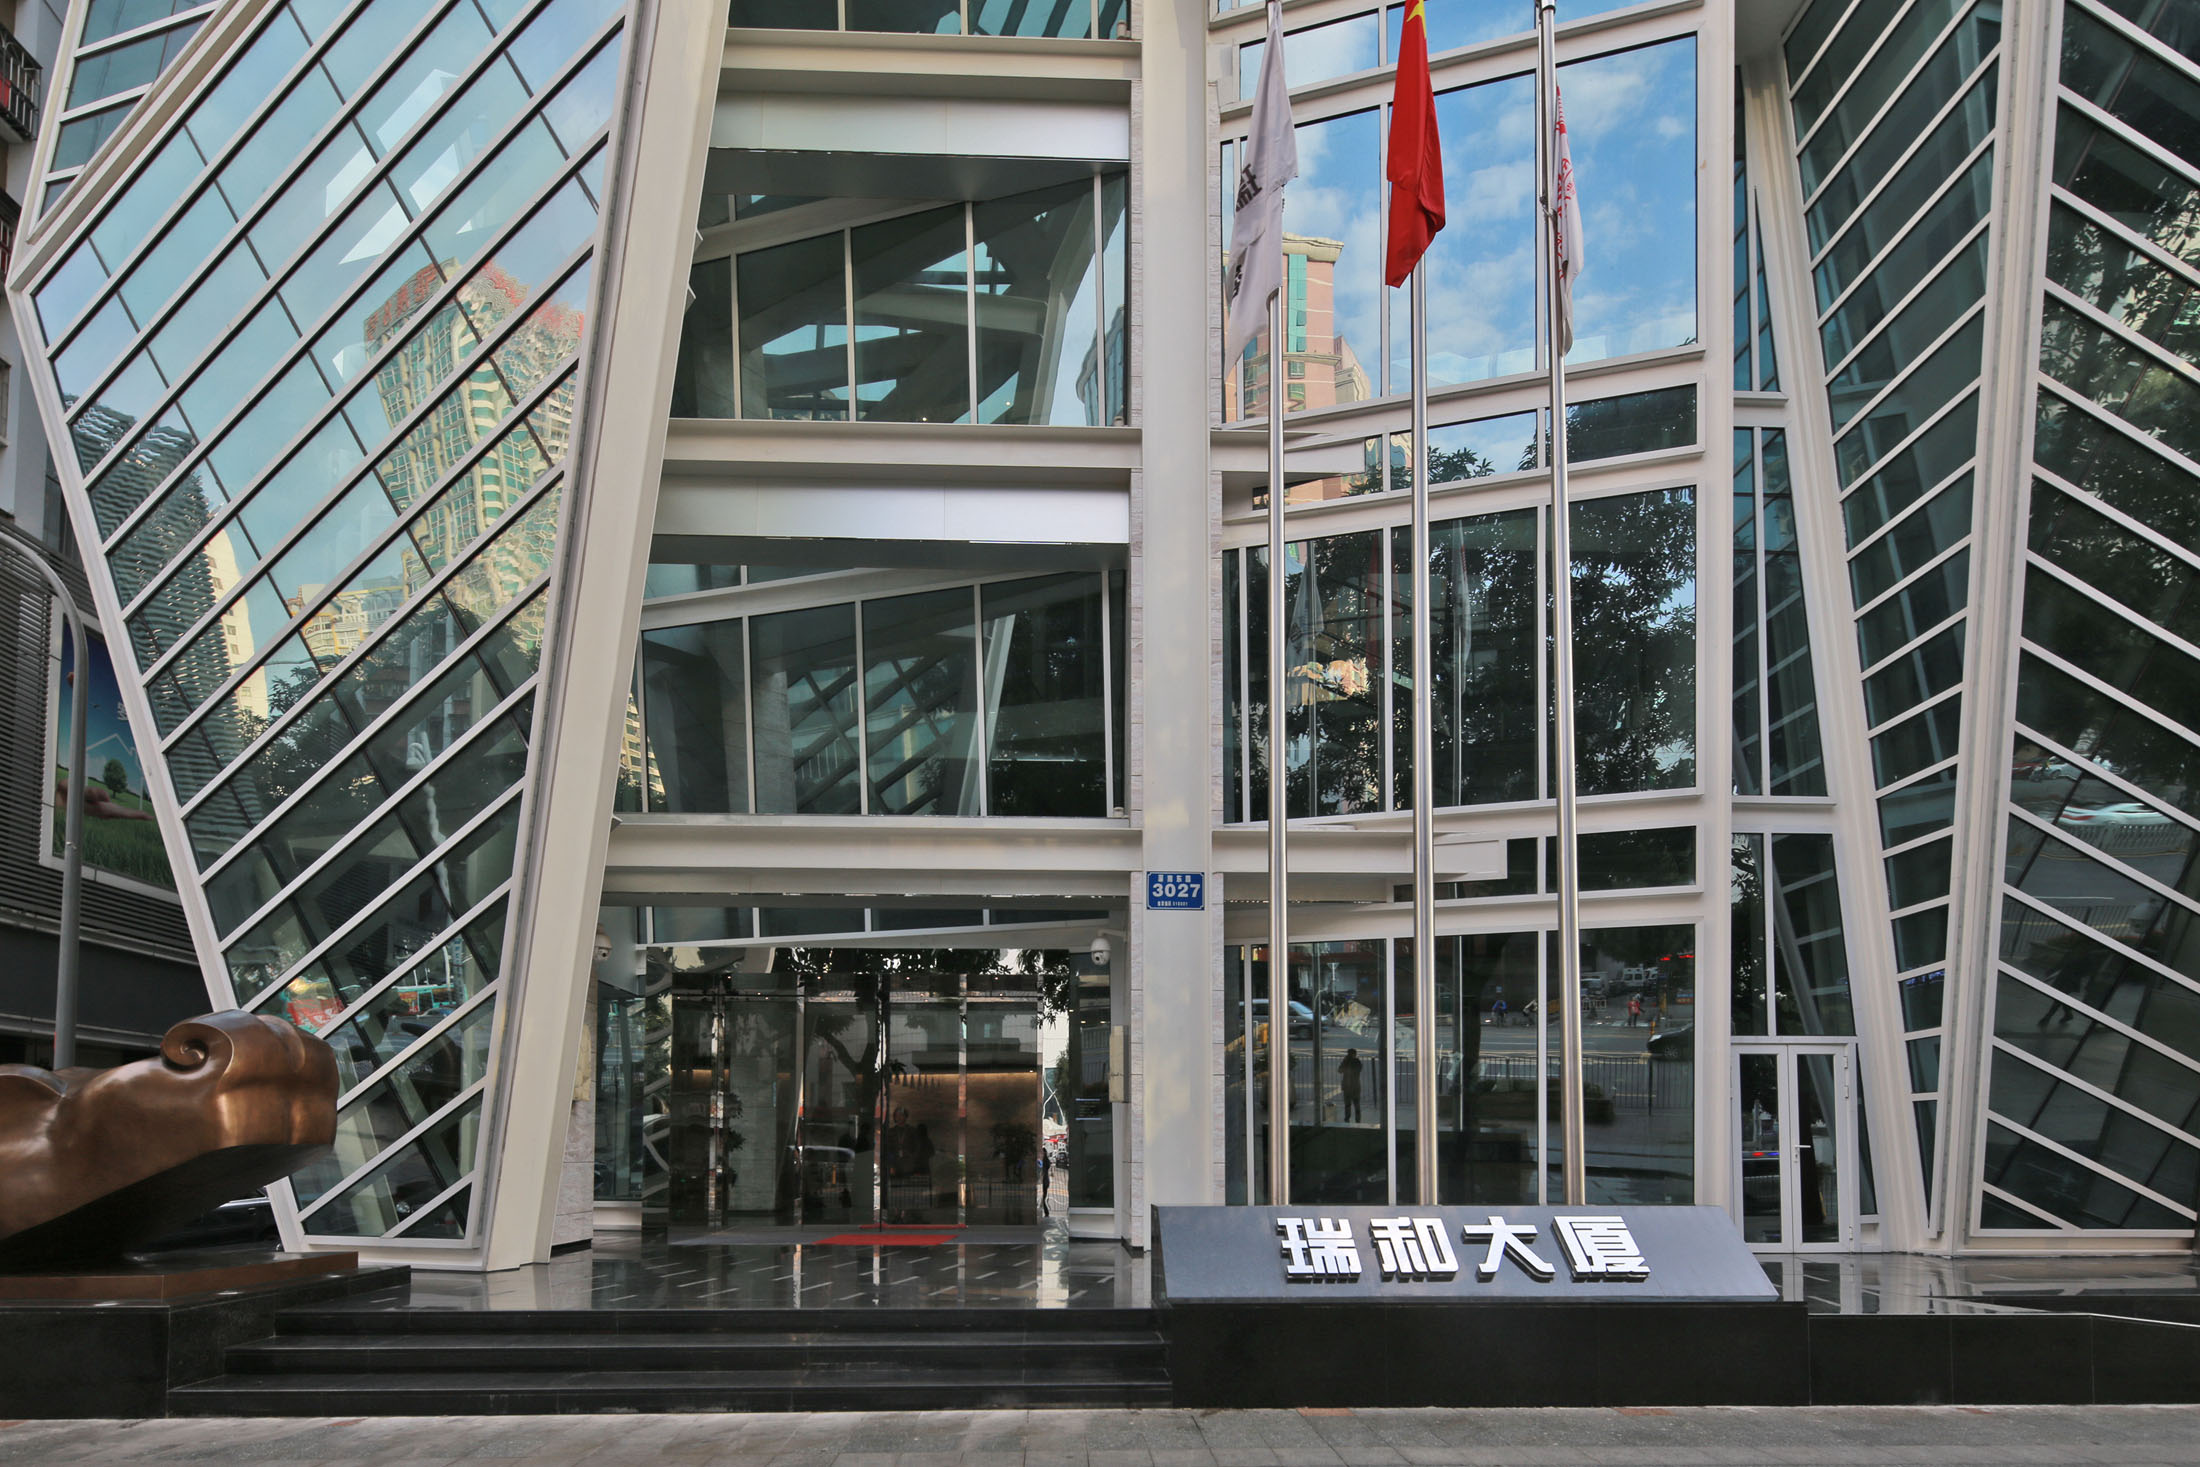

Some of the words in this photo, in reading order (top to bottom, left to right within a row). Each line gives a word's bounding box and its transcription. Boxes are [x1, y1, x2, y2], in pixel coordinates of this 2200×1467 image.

[1152, 883, 1201, 898] 3027
[1276, 1216, 1651, 1280] 瑞和大厦
